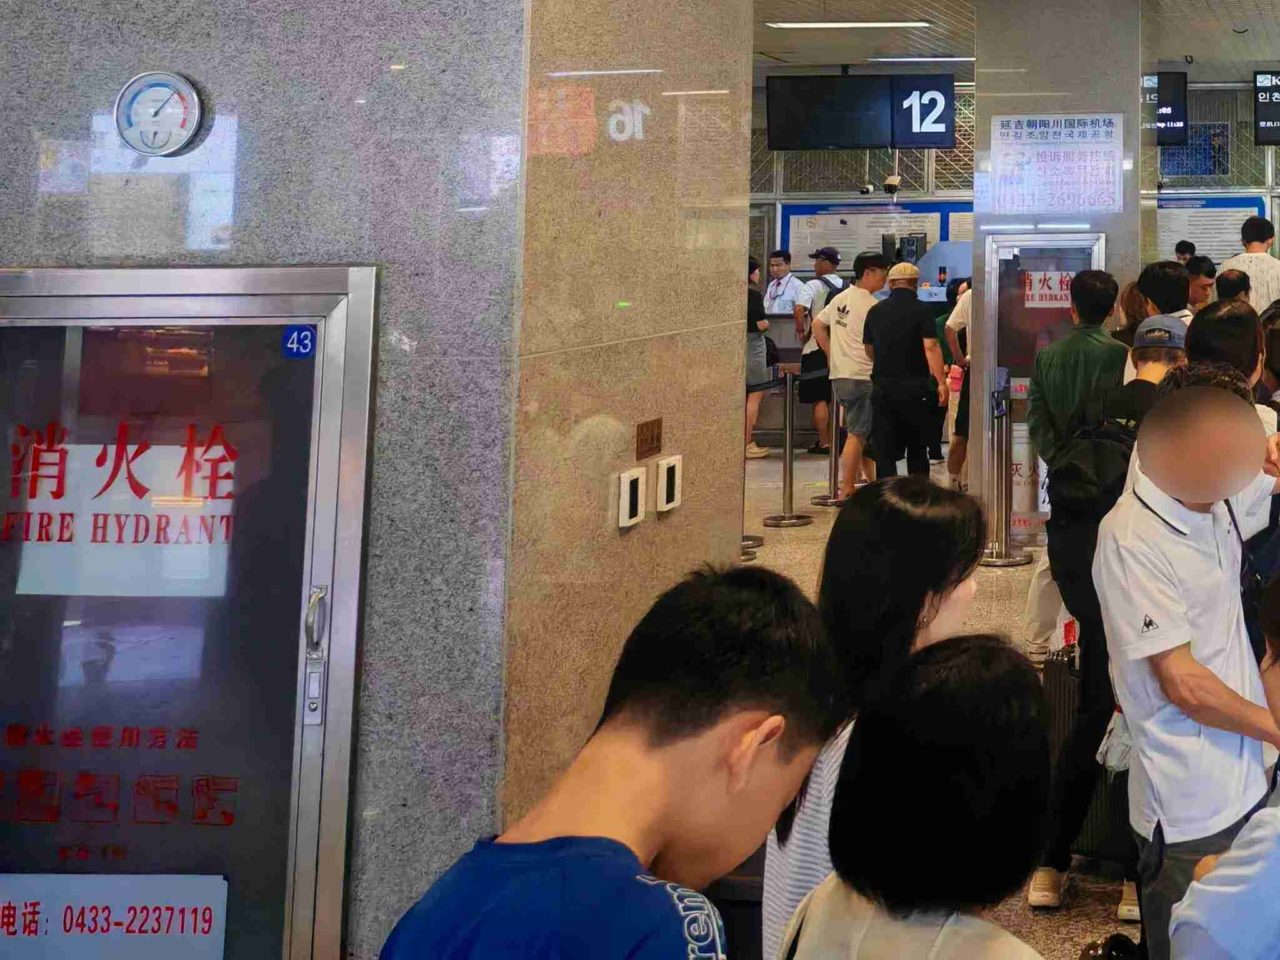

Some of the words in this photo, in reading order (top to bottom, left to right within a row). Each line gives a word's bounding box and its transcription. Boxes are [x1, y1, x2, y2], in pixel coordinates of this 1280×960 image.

[902, 90, 946, 133] 12
[1000, 118, 1114, 130] 延吉朝阳川国际机场
[286, 331, 312, 354] 43
[10, 420, 240, 501] 消火栓
[2, 512, 75, 543] FIRE
[90, 513, 235, 544] HYDRANT
[62, 905, 213, 935] 0433-2237119
